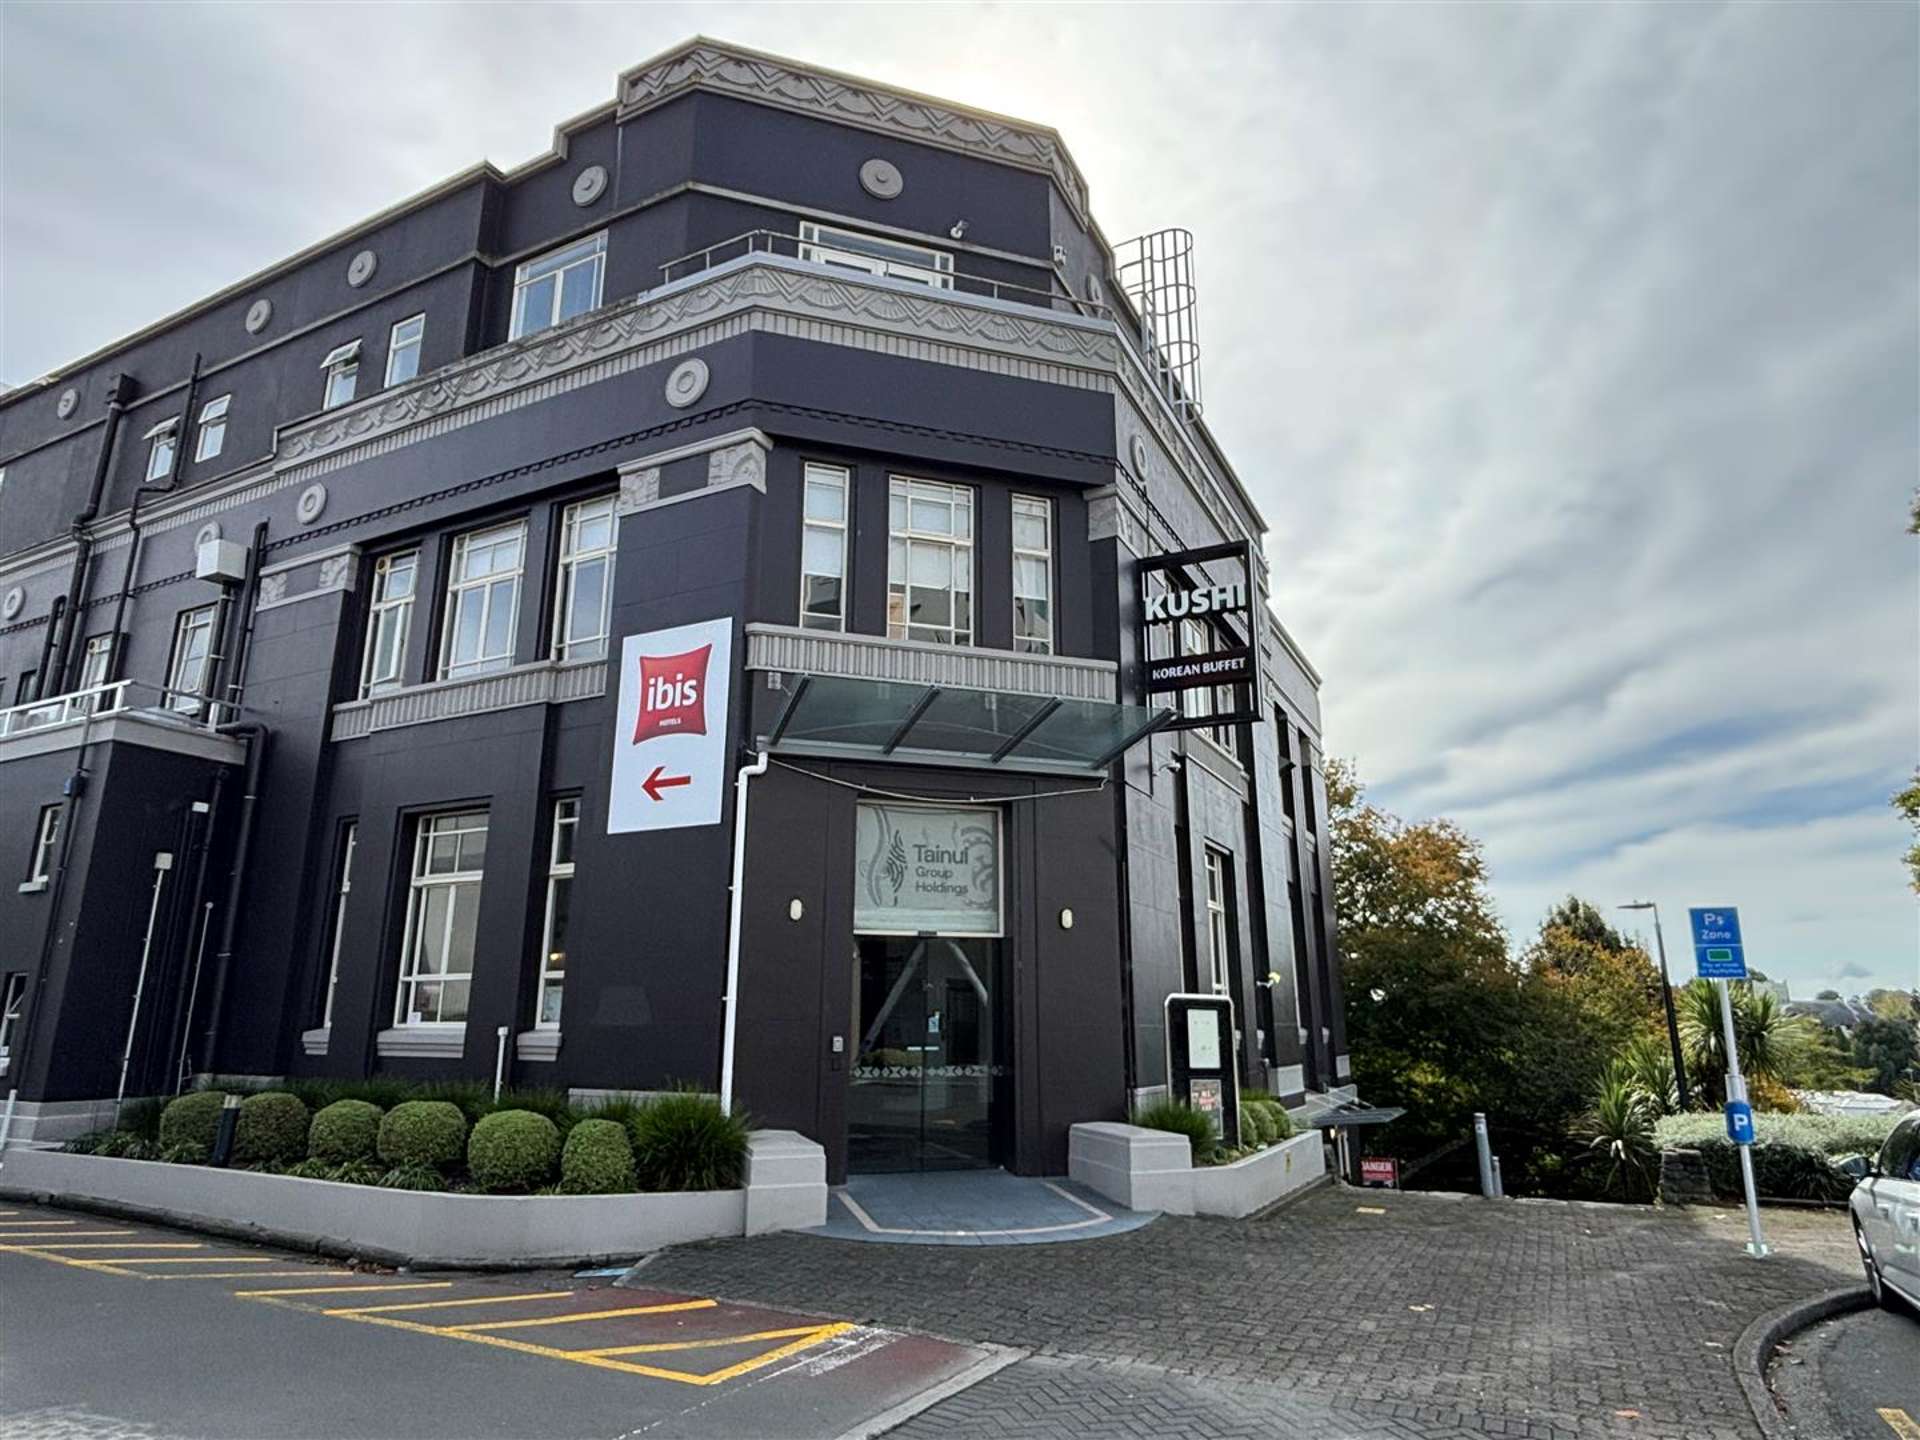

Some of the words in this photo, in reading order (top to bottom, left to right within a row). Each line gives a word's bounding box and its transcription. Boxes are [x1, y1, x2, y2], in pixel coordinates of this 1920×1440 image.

[1145, 582, 1246, 621] KUSHI
[1152, 664, 1201, 680] KOREAN
[1202, 657, 1246, 673] BUFFET
[647, 672, 697, 712] ibis
[912, 843, 969, 864] Tainui
[915, 866, 953, 879] Group
[915, 881, 969, 896] Holdings
[1702, 929, 1731, 939] Zone
[1733, 1113, 1749, 1132] P
